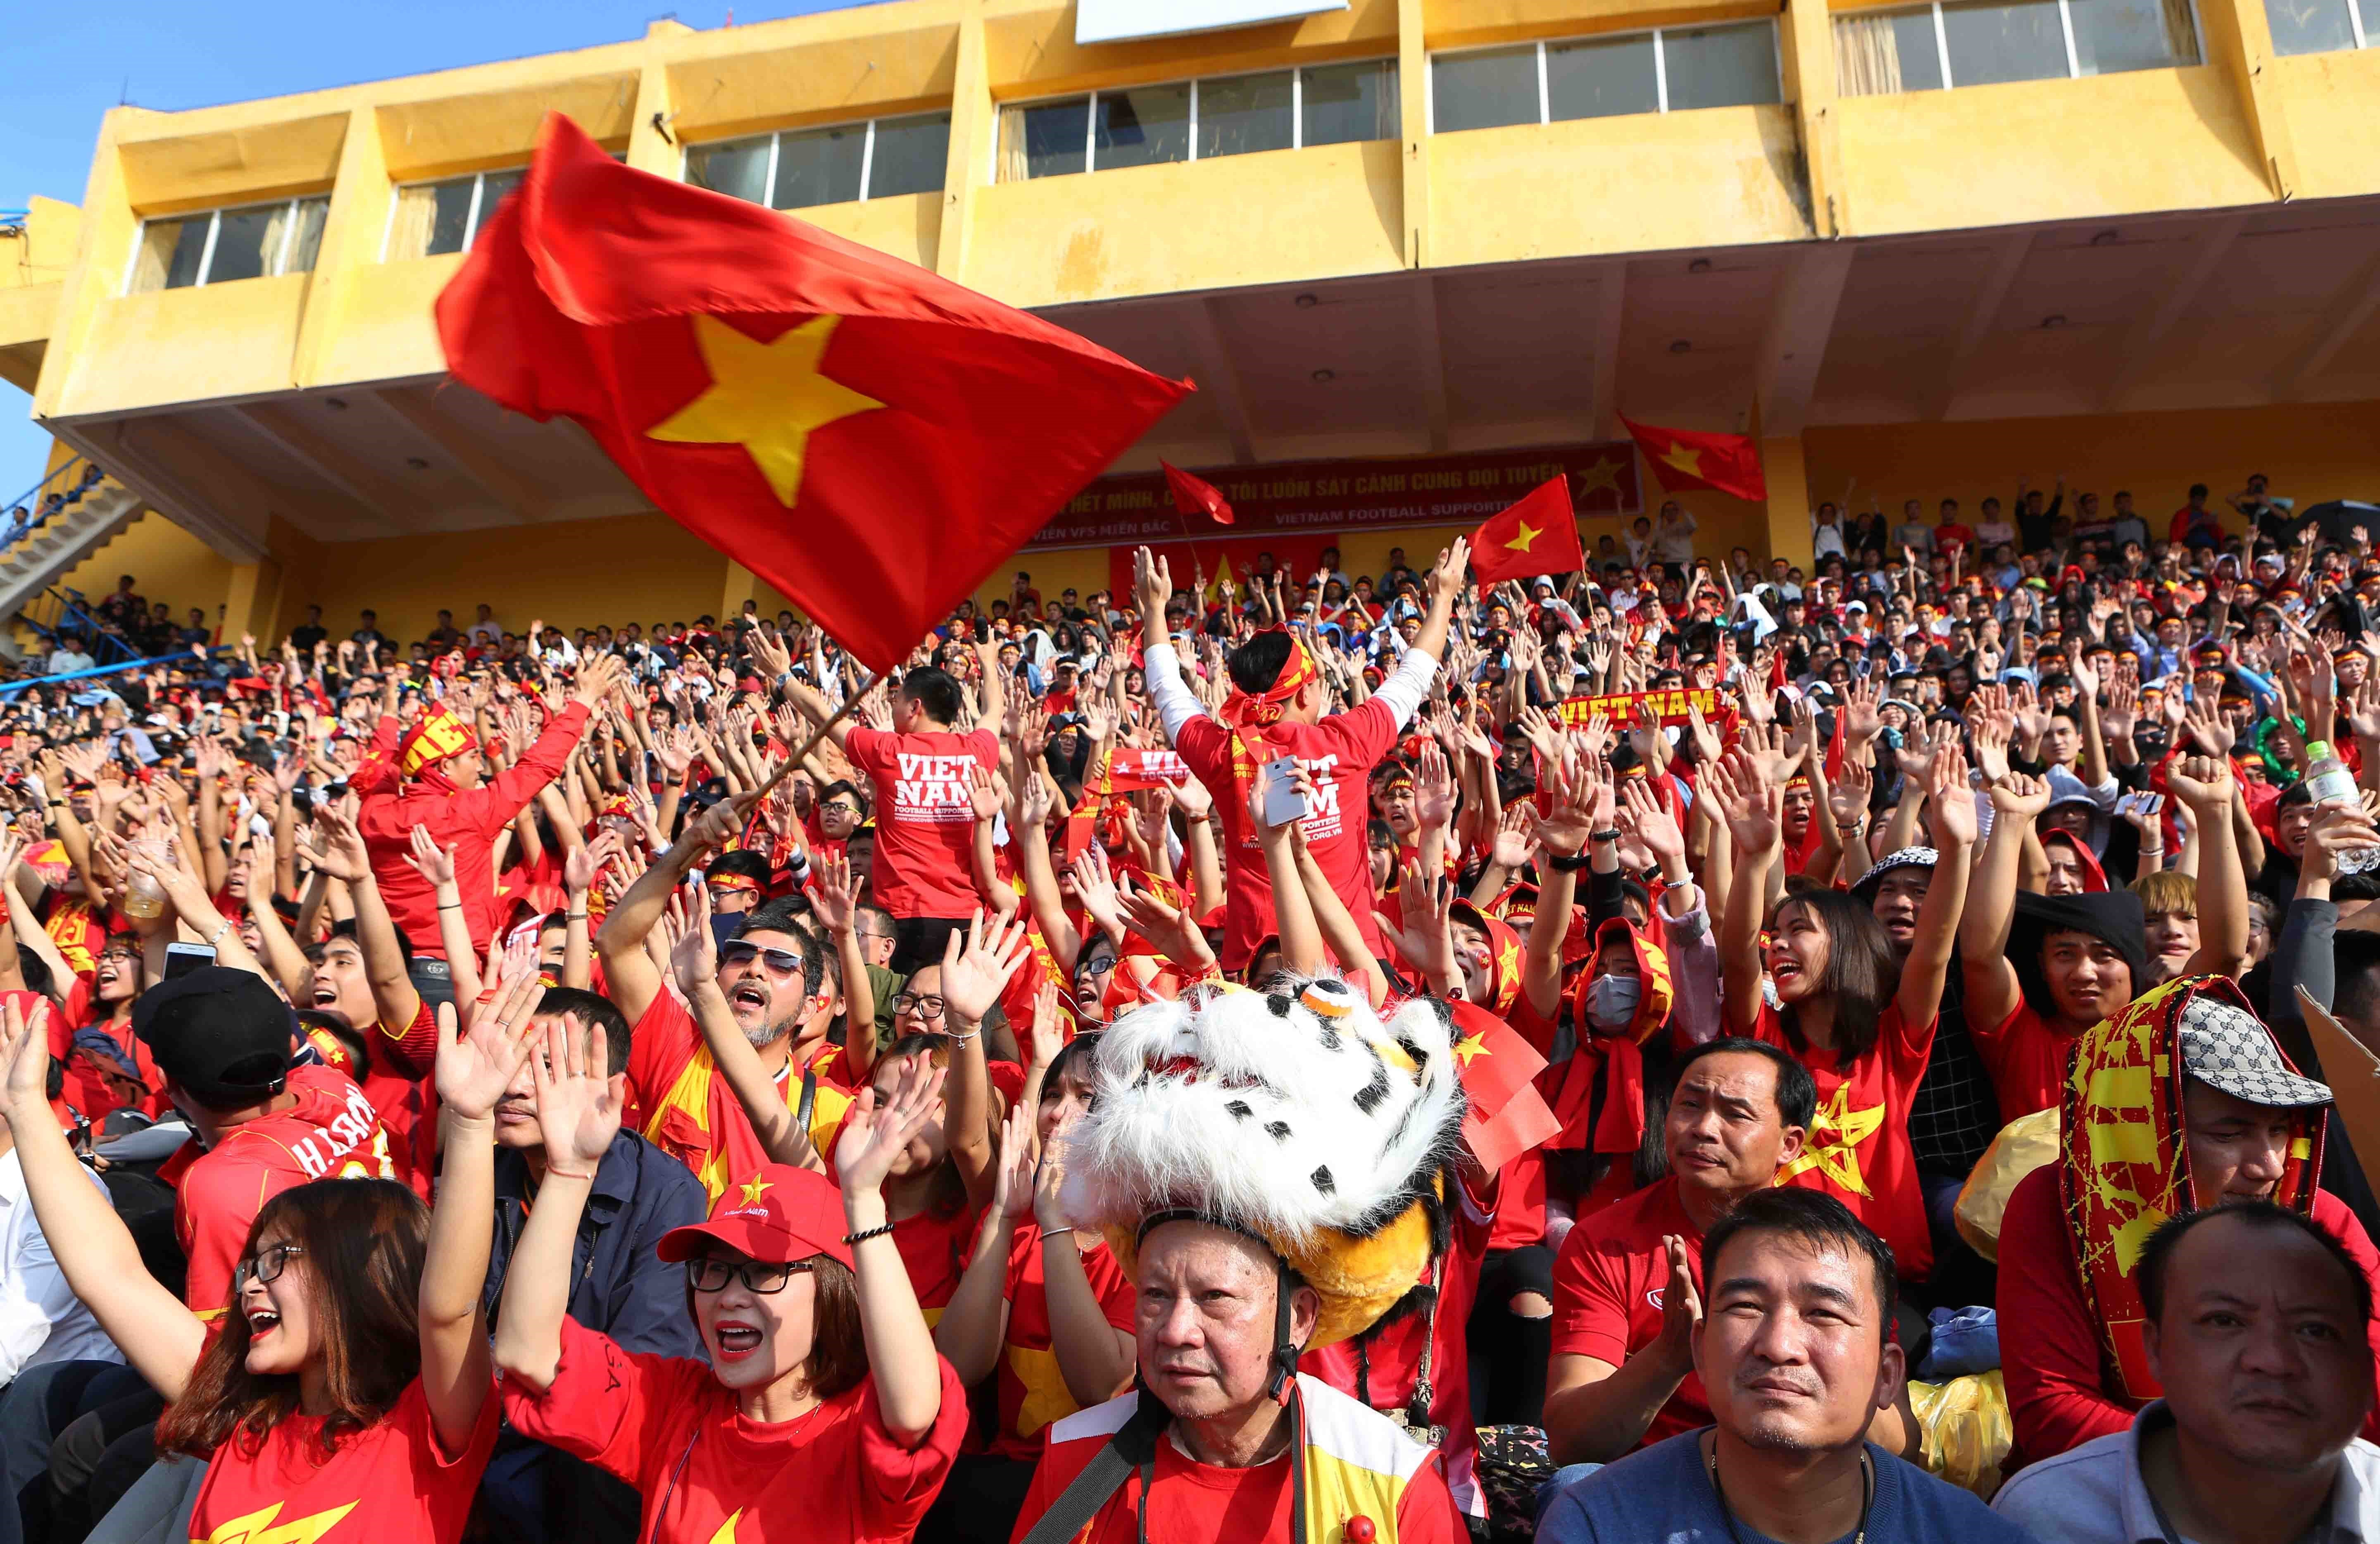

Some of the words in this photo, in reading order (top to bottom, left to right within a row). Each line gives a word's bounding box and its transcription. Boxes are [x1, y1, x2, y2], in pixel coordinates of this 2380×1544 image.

[1263, 478, 1309, 498] LUÔN
[1276, 510, 1343, 525] VIETNAM
[1348, 505, 1426, 520] FOOTBALL
[1431, 502, 1511, 516] SUPPORTE
[1645, 690, 1715, 717] NAM
[897, 753, 977, 781] VIET
[895, 779, 972, 807] NAM
[894, 806, 933, 814] FOOTBALL
[1301, 815, 1341, 829] PORTERS
